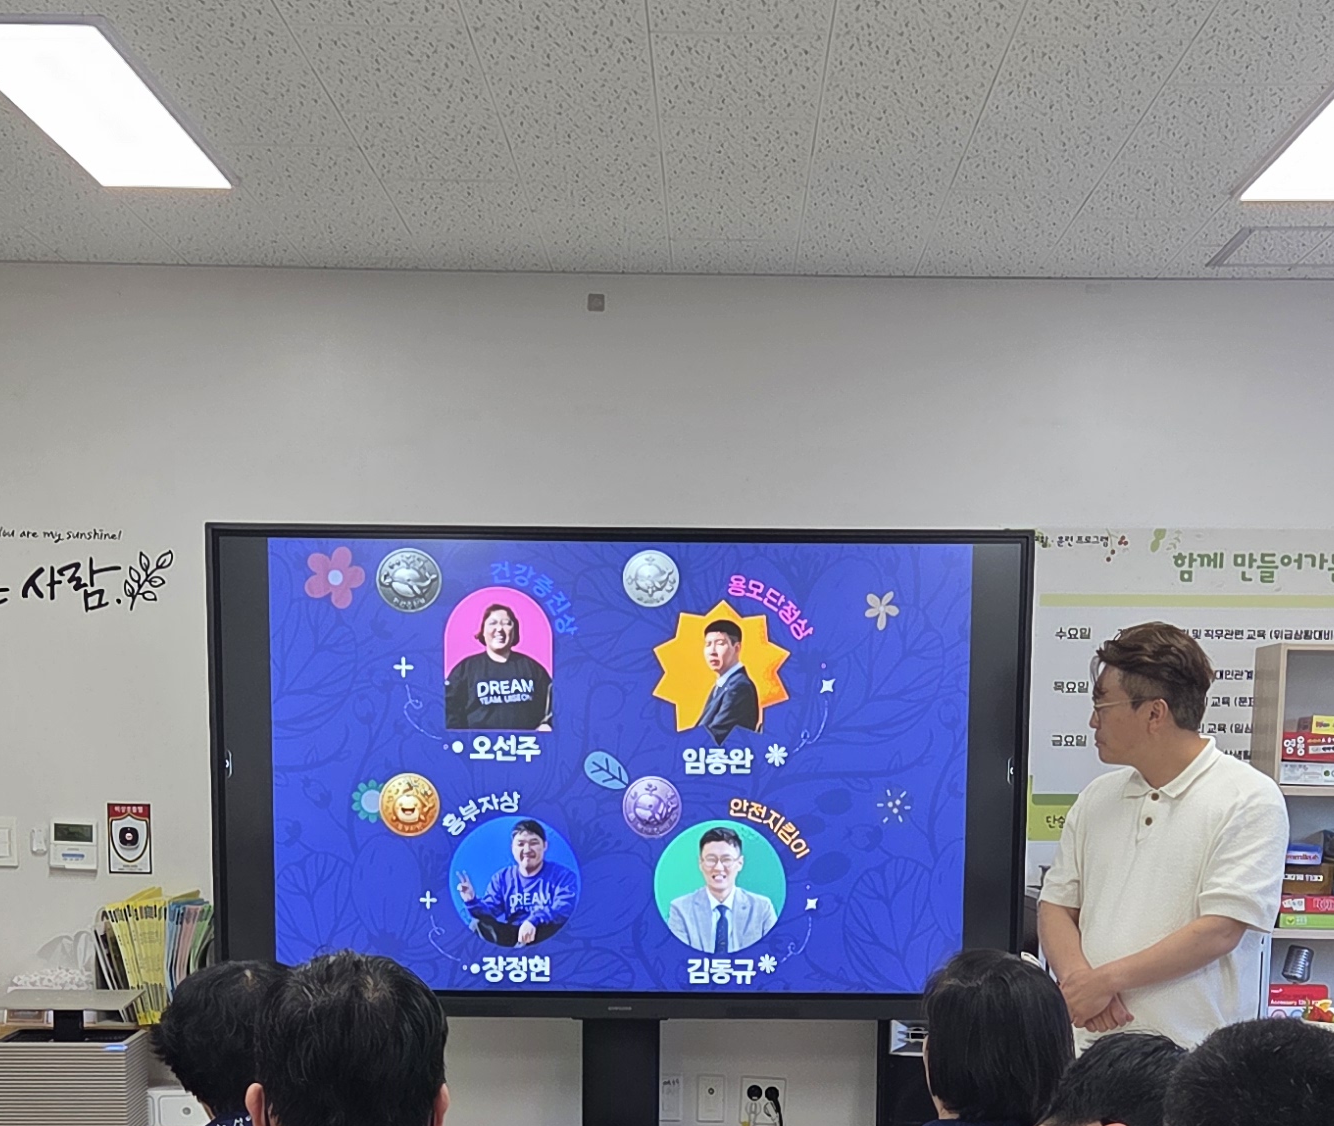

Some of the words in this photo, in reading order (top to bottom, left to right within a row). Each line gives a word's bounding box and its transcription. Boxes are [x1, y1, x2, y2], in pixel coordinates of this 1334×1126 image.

[20, 530, 38, 538] are
[43, 531, 64, 543] my
[1076, 535, 1109, 548] 프로그램
[1173, 552, 1224, 583] 함께
[21, 556, 123, 613] 사람.
[490, 560, 579, 637] 건강증진상
[1055, 627, 1091, 640] 수요일
[1204, 629, 1244, 640] 직무관련
[1246, 629, 1266, 640] 교육
[476, 678, 534, 698] DREAM
[1053, 681, 1089, 694] 목요일
[1211, 696, 1230, 707] 교육
[1207, 723, 1227, 734] 교육
[469, 734, 541, 763] 오선주
[1051, 735, 1087, 747] 금요일
[682, 747, 754, 775] 임종완
[442, 791, 521, 836] 흥부자상
[728, 798, 810, 860] 안전지킴이
[482, 955, 551, 983] 장정현
[687, 958, 757, 985] 김동규
